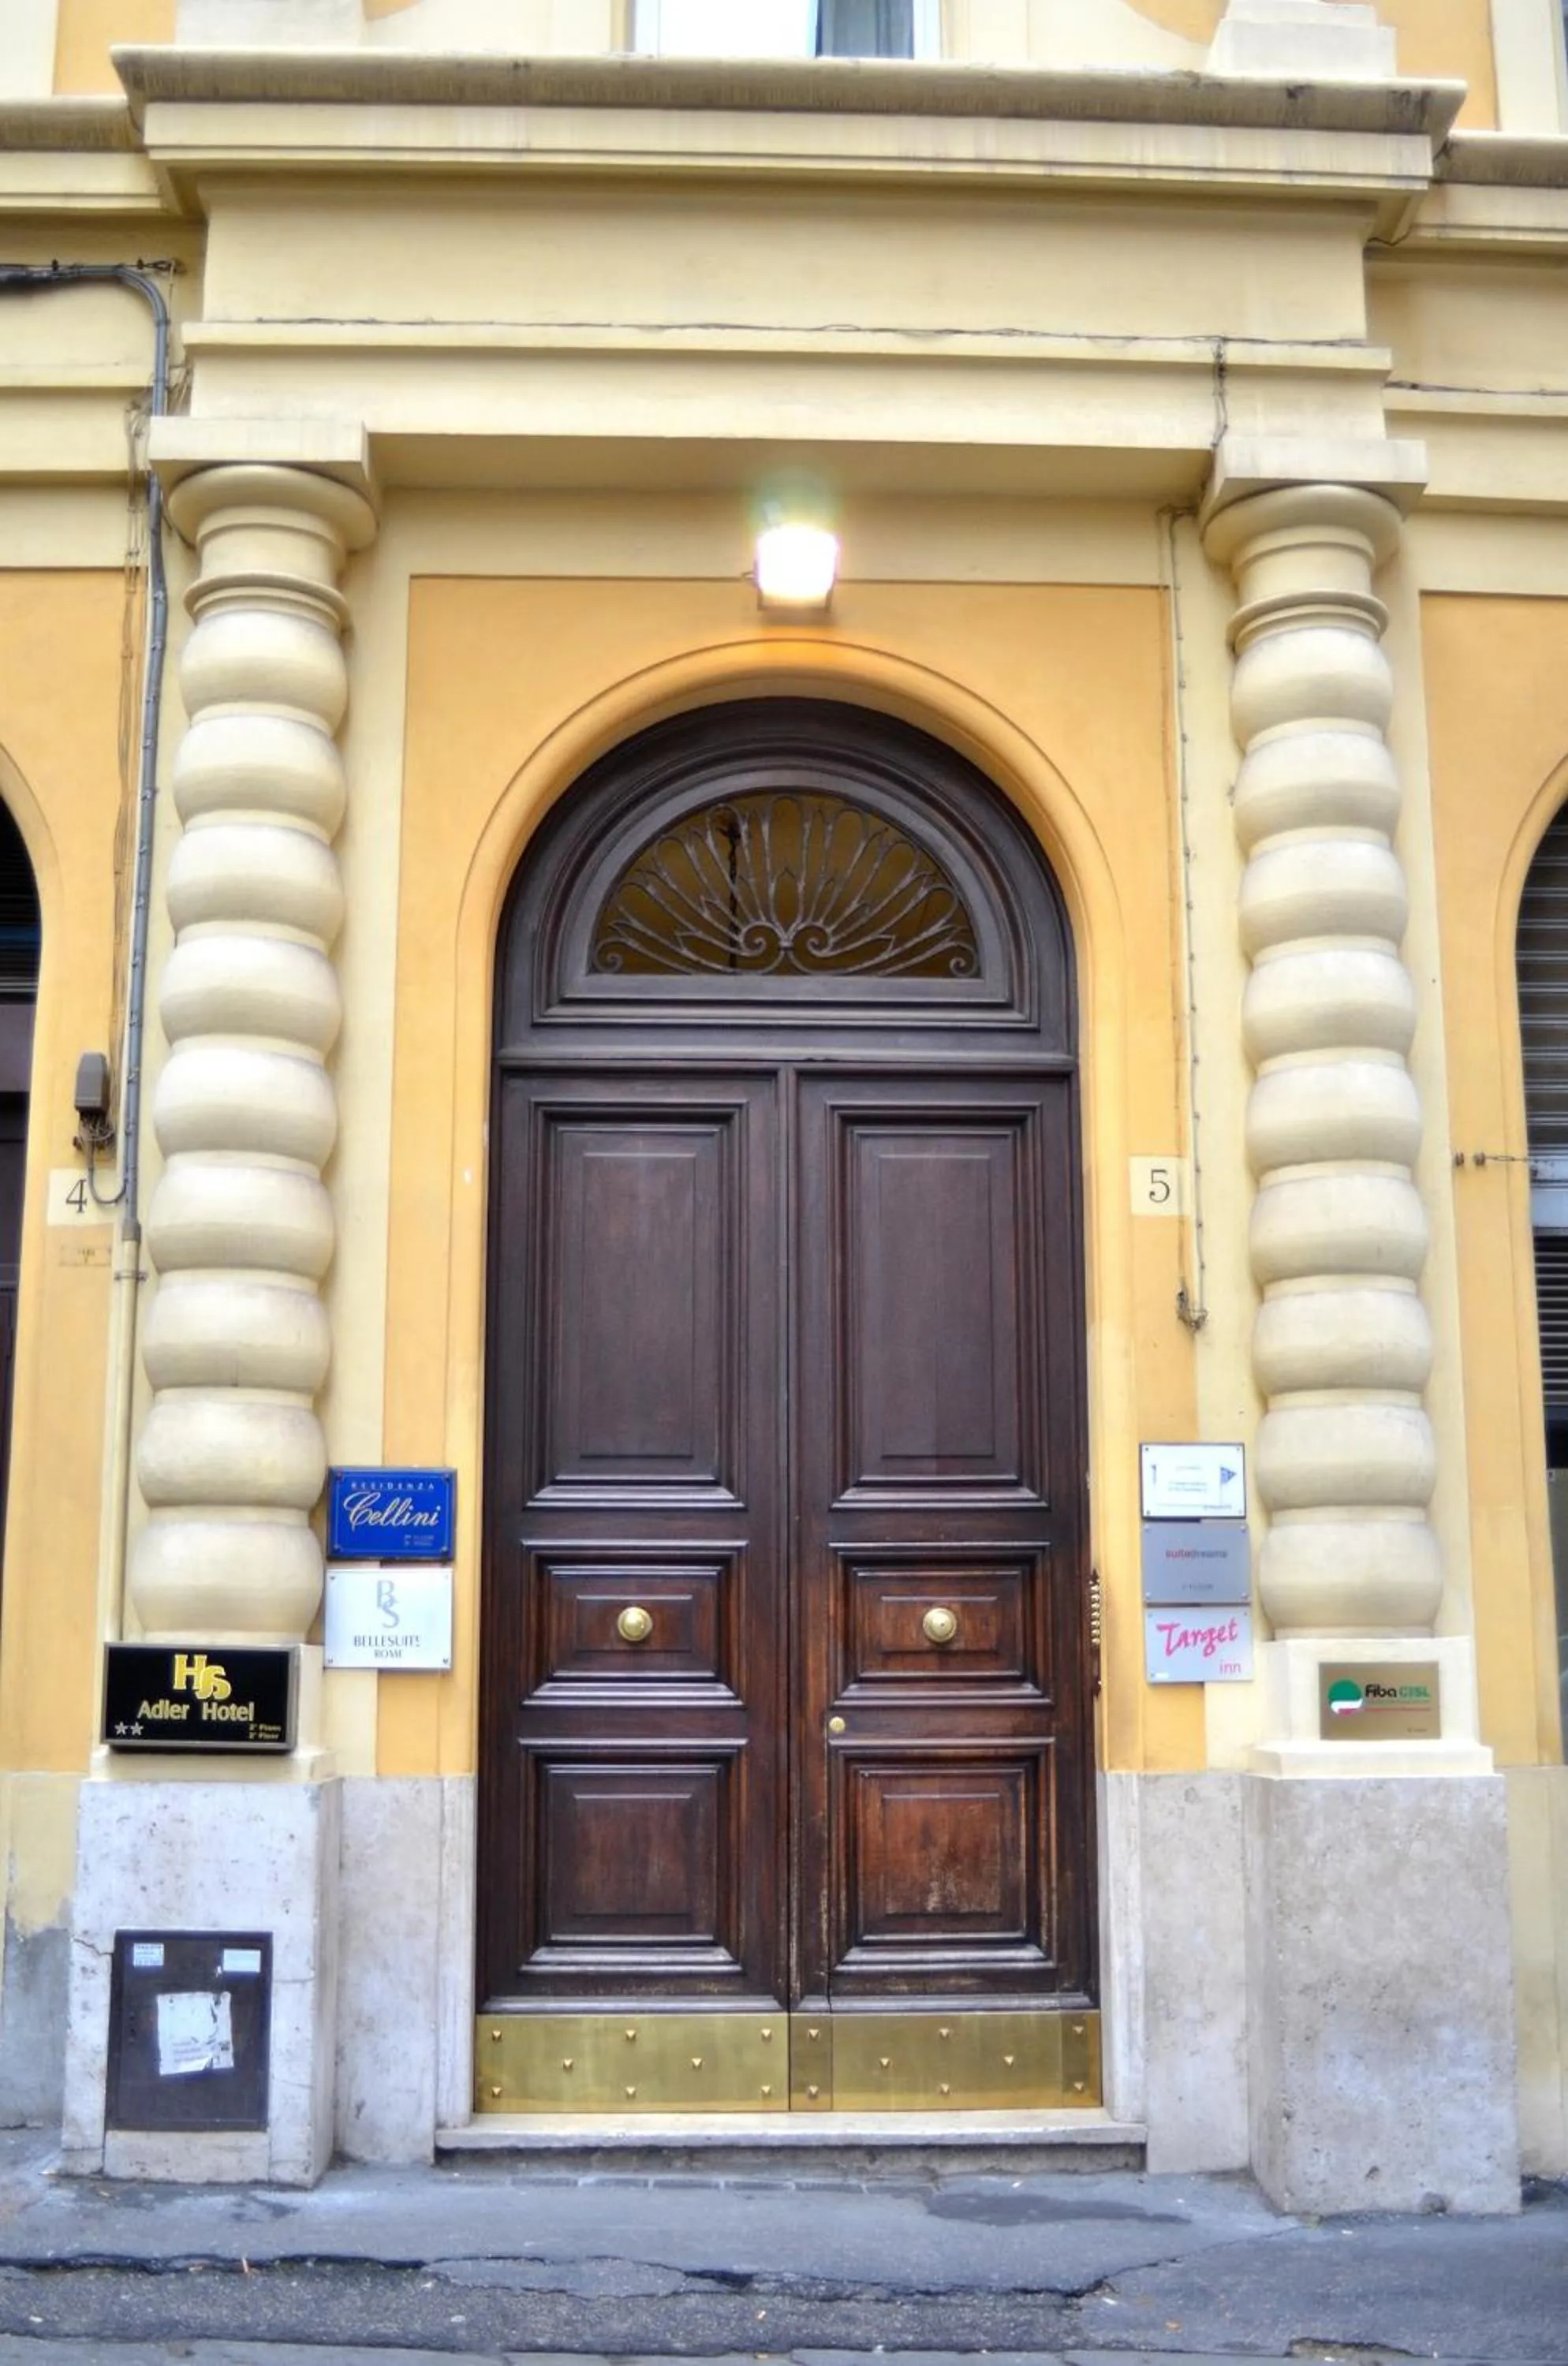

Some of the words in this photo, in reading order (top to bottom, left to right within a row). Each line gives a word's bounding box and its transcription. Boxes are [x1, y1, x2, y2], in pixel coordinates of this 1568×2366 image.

[65, 1178, 88, 1214] 4
[1149, 1169, 1170, 1204] 5
[351, 1482, 435, 1491] RESIDENZA
[343, 1491, 441, 1532] Cellini
[1156, 1618, 1238, 1658] Target
[1219, 1660, 1241, 1674] inn
[1365, 1684, 1398, 1697] Fiba
[136, 1700, 190, 1719] Adler
[202, 1701, 255, 1721] Hotel
